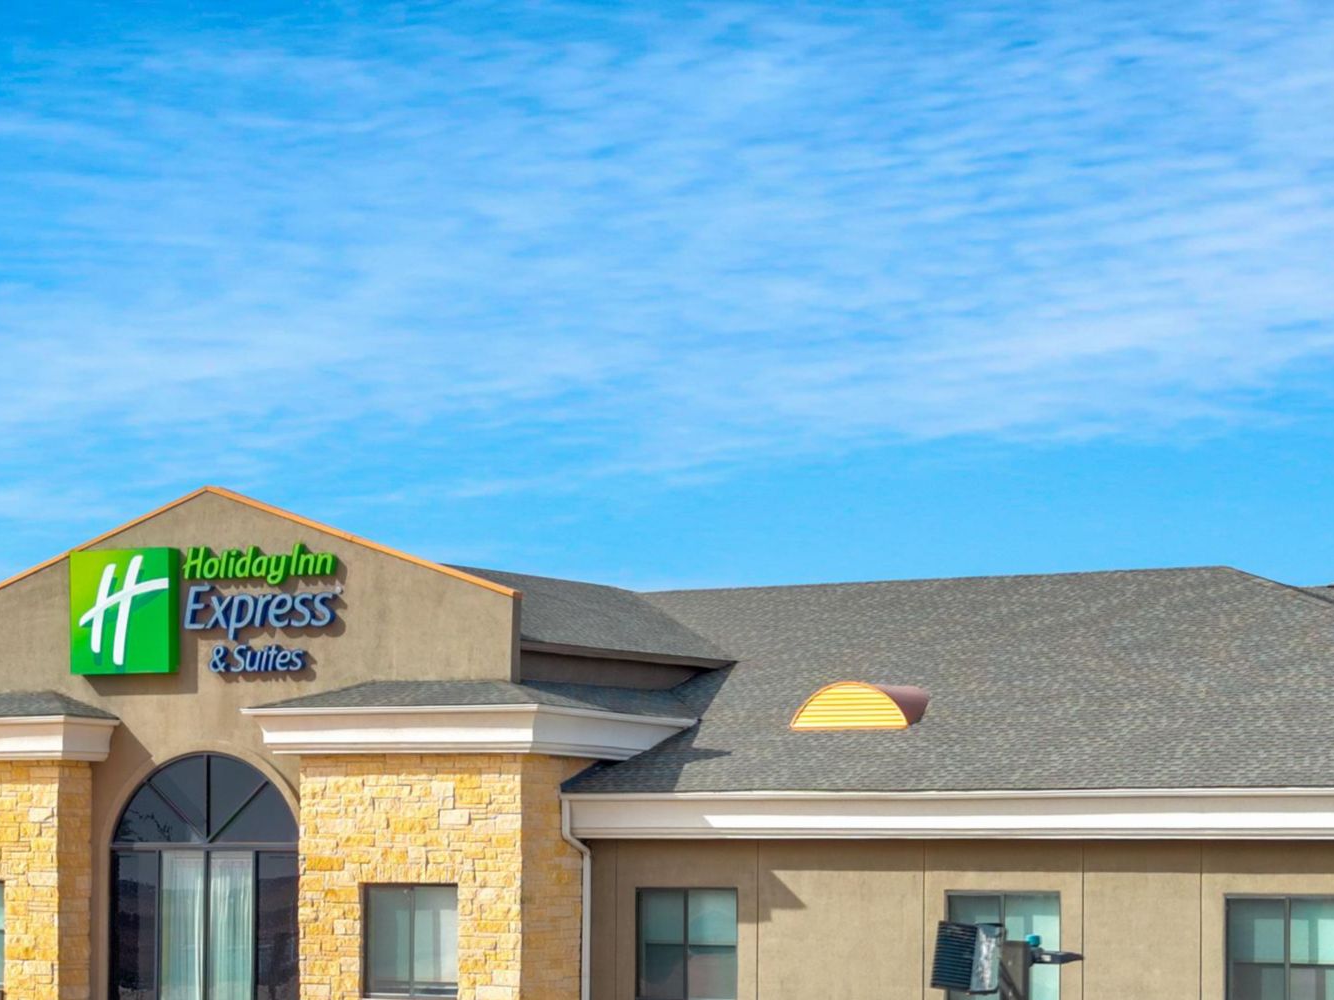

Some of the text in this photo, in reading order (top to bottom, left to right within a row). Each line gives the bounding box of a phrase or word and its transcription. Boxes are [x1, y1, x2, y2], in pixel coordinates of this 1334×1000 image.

[182, 543, 335, 585] Holiday Inn
[79, 554, 169, 666] H
[183, 584, 337, 641] Express
[208, 644, 305, 673] & Suites
